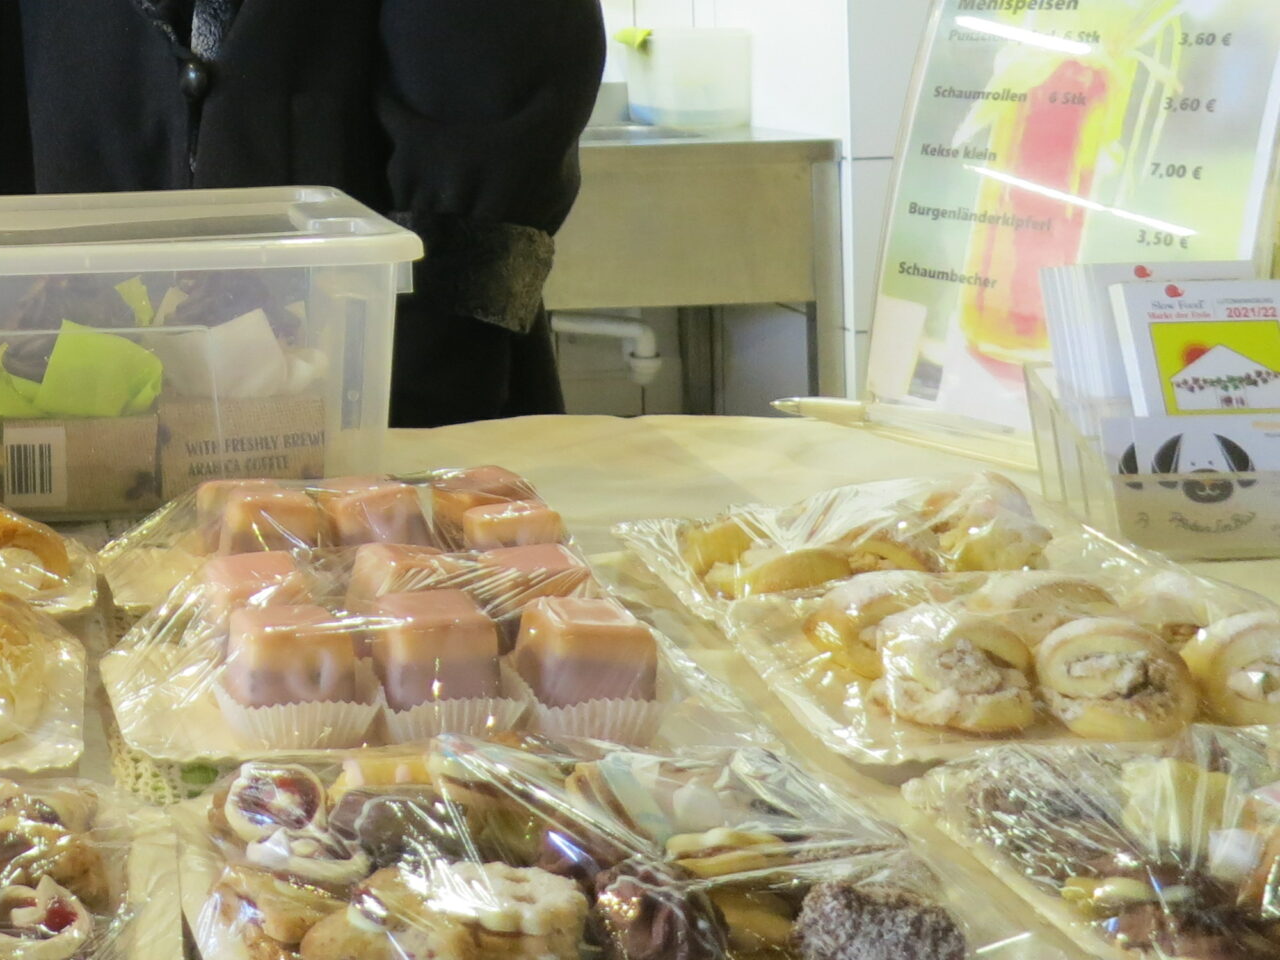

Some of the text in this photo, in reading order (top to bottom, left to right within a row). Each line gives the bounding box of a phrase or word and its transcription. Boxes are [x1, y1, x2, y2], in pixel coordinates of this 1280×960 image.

[1177, 31, 1218, 48] 3,60
[1221, 32, 1233, 46] €
[933, 85, 1217, 114] Schaumrollen 6 Stk 3,60 €
[921, 143, 1203, 180] Kekse klein 7,00 €
[1136, 229, 1174, 248] 3,50
[1180, 235, 1189, 250] €
[898, 261, 998, 289] Schaumbecher
